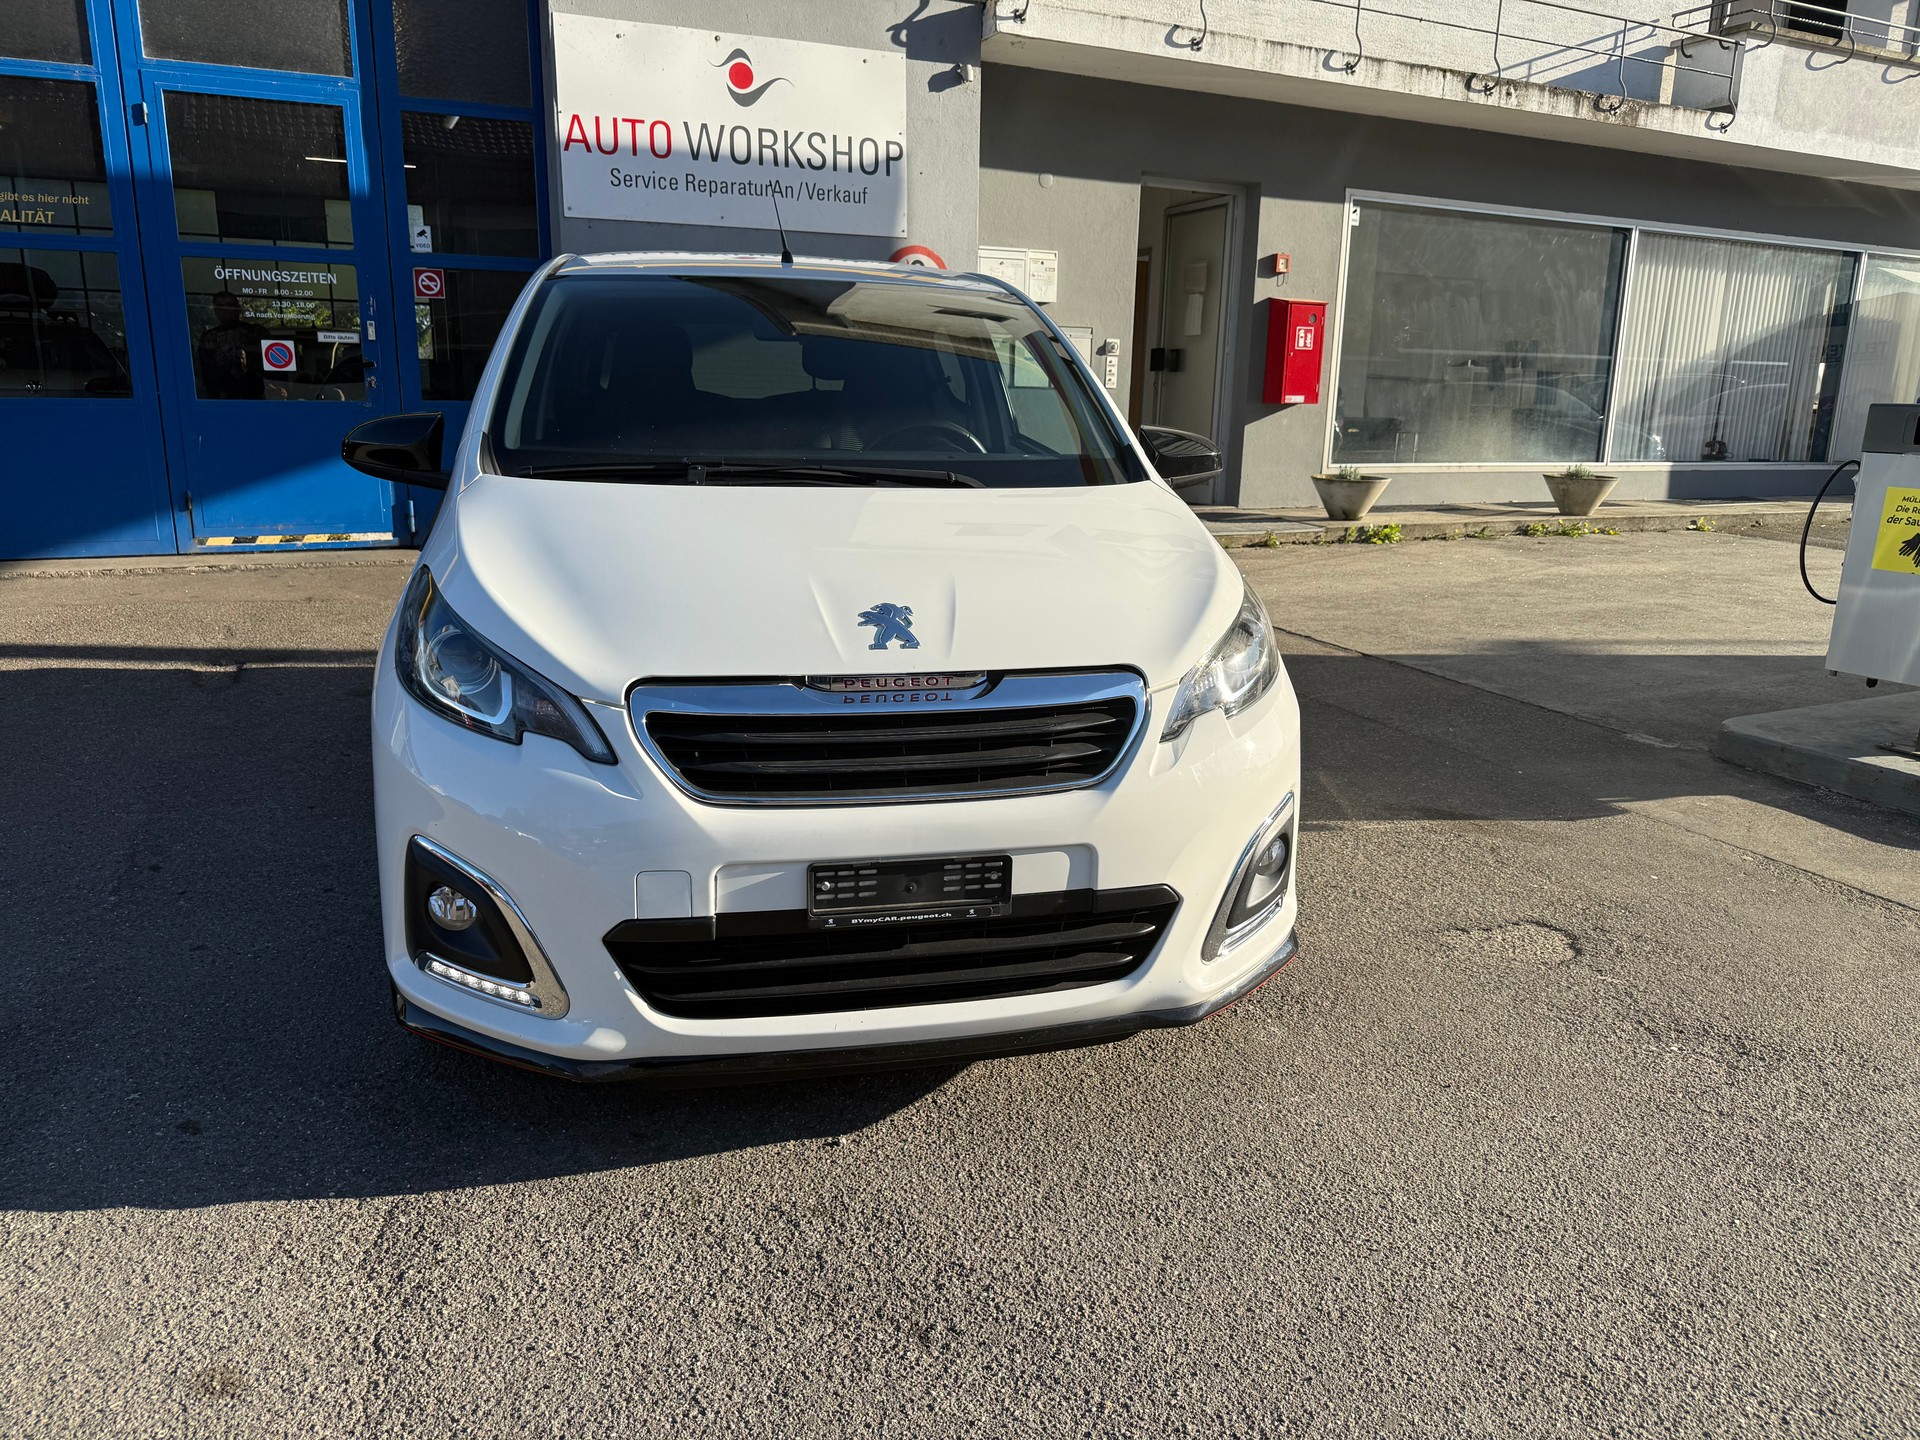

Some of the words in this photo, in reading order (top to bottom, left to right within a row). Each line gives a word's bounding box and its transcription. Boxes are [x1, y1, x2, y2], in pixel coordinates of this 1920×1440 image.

[563, 113, 673, 160] AUTO
[683, 121, 904, 177] WORKSHOP
[610, 167, 679, 191] Service
[685, 173, 771, 198] Reparatur
[21, 193, 35, 202] es
[37, 193, 59, 203] hier
[62, 194, 89, 205] nicht
[214, 265, 338, 285] ÖFFNUNGSZEITEN
[242, 287, 254, 295] MO
[274, 288, 290, 296] 8.00
[294, 289, 314, 297] 12.00
[296, 301, 316, 309] 18.00
[1895, 504, 1911, 513] Die
[1886, 514, 1904, 525] der
[843, 676, 954, 689] PEUGEOT
[851, 912, 952, 924] BYmyCAR.peugeot.ch
